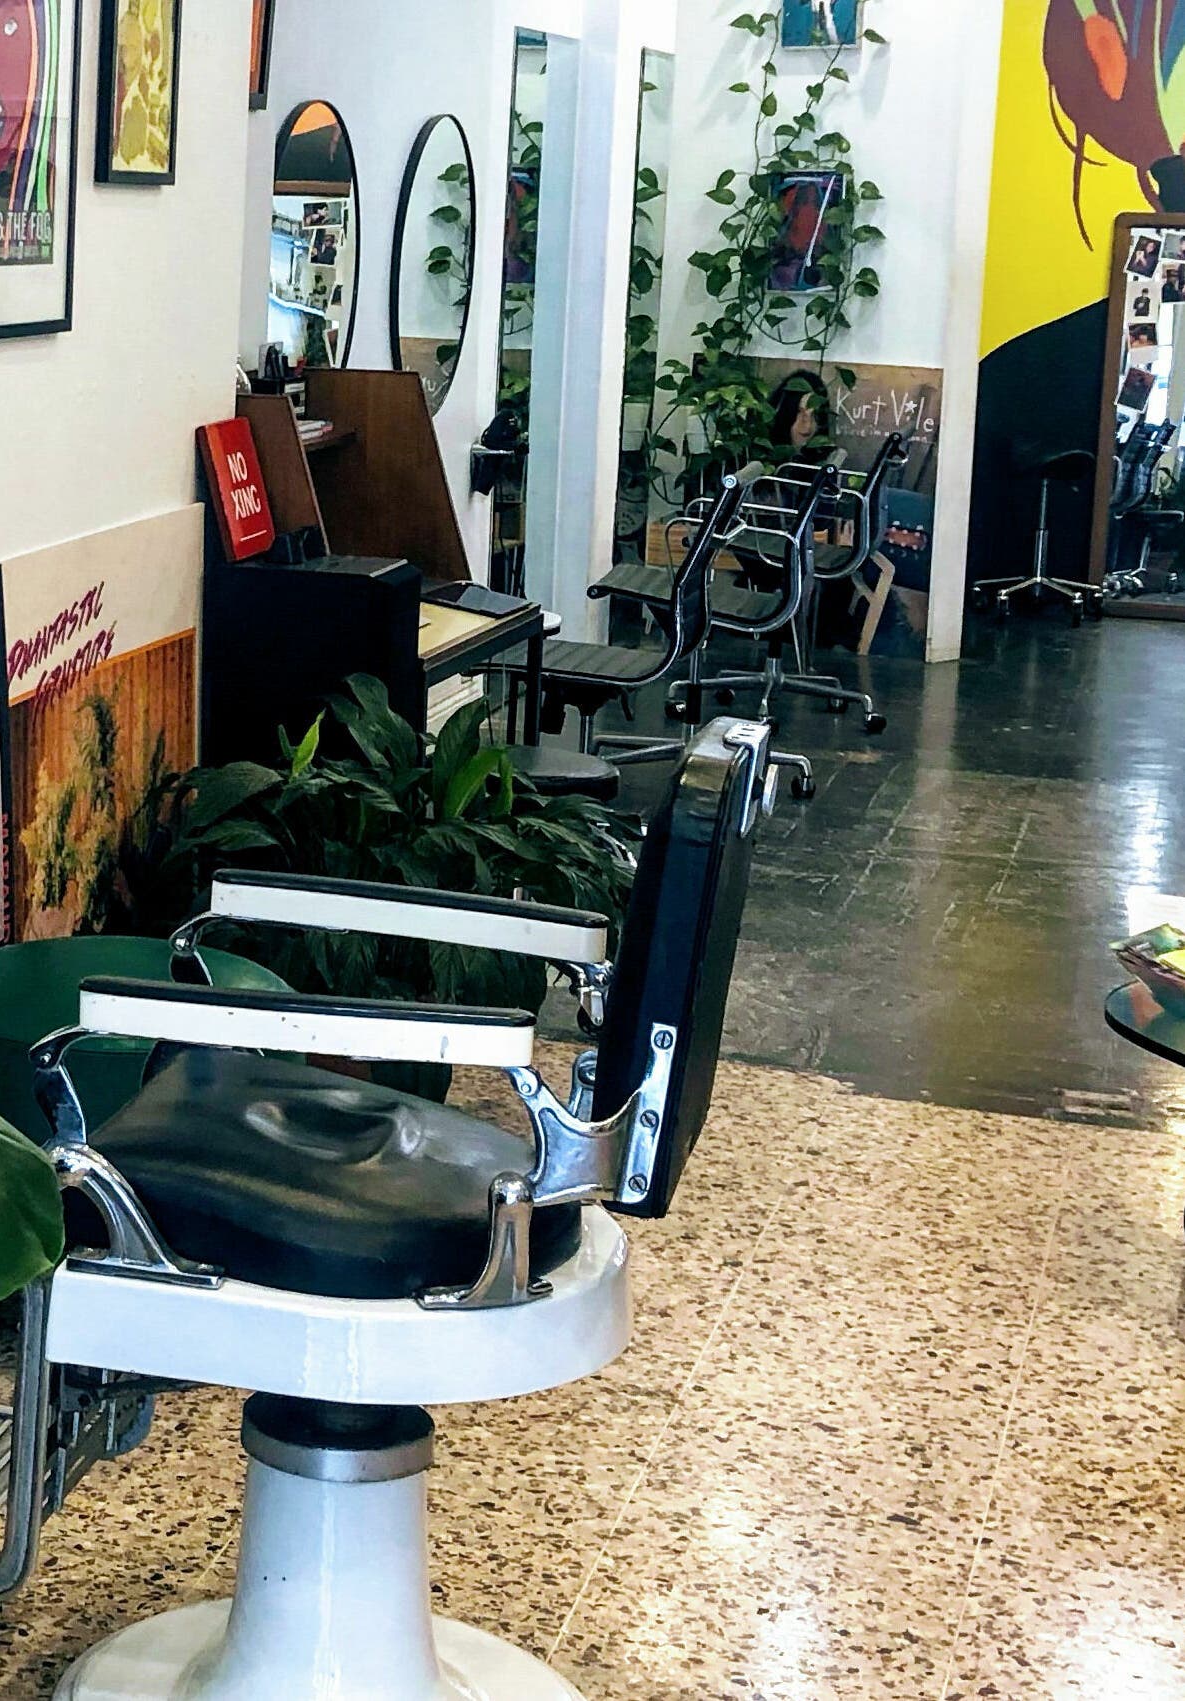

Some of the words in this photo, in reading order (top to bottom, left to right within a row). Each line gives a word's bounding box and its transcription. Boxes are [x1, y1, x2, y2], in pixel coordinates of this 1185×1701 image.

[6, 211, 27, 241] THE
[836, 386, 887, 425] Kurt
[226, 451, 248, 484] NO
